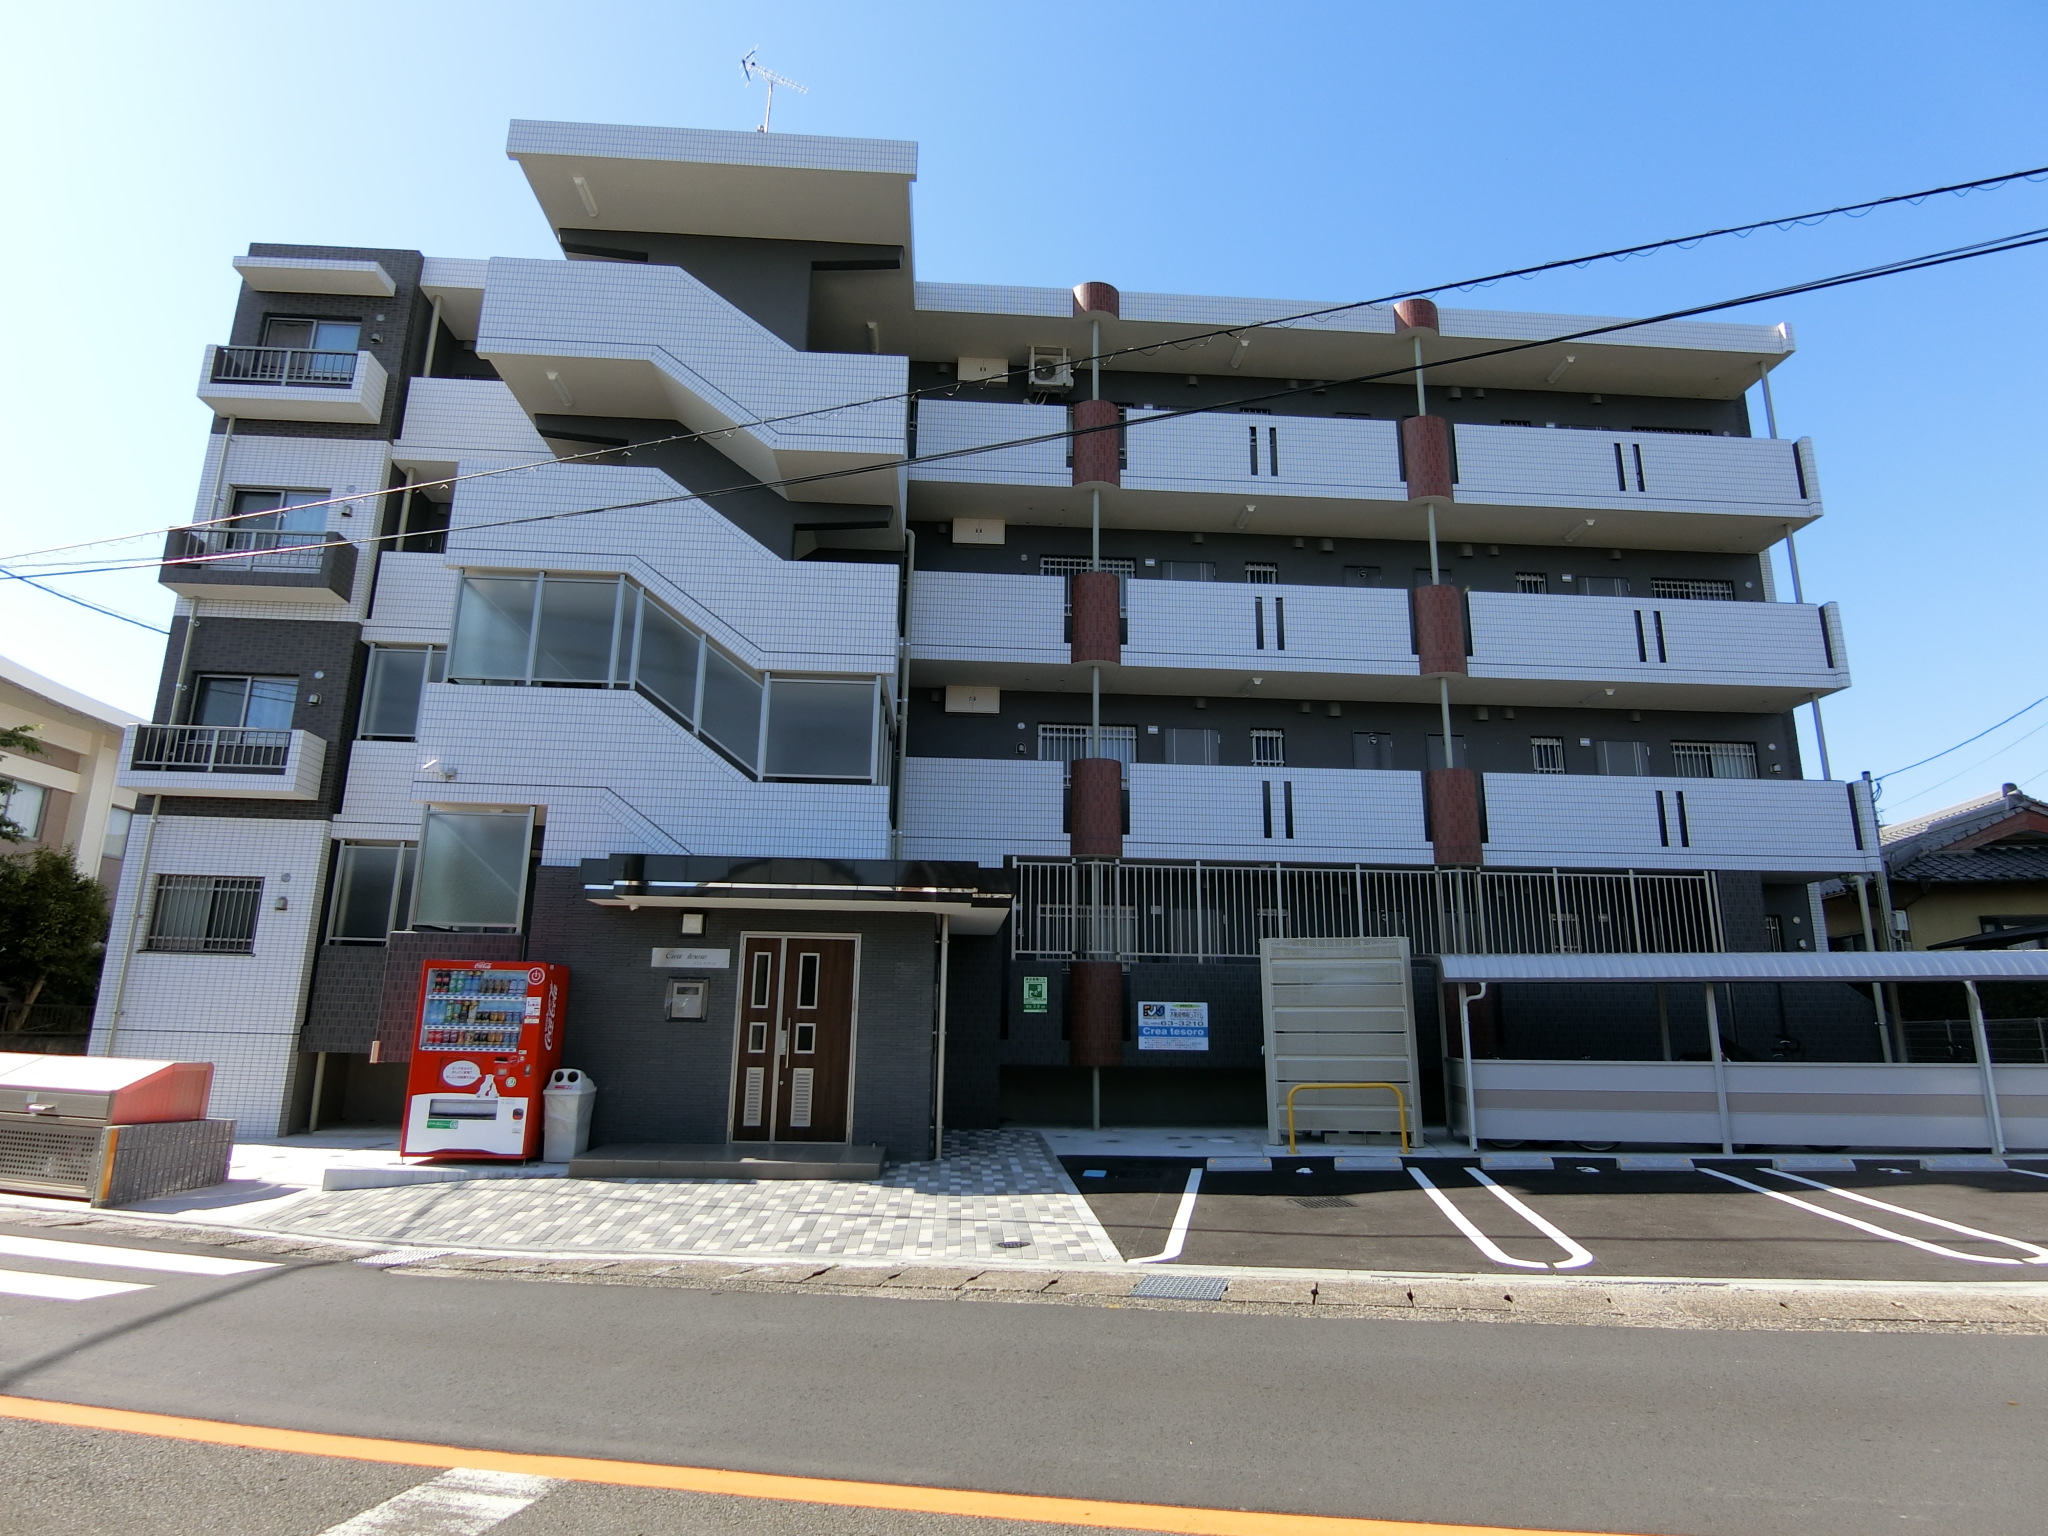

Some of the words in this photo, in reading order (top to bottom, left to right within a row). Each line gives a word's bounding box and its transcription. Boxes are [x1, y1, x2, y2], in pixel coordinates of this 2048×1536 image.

[544, 979, 558, 1051] Coca-Cola
[1142, 1027, 1168, 1035] Crea
[1170, 1027, 1205, 1036] tesoro
